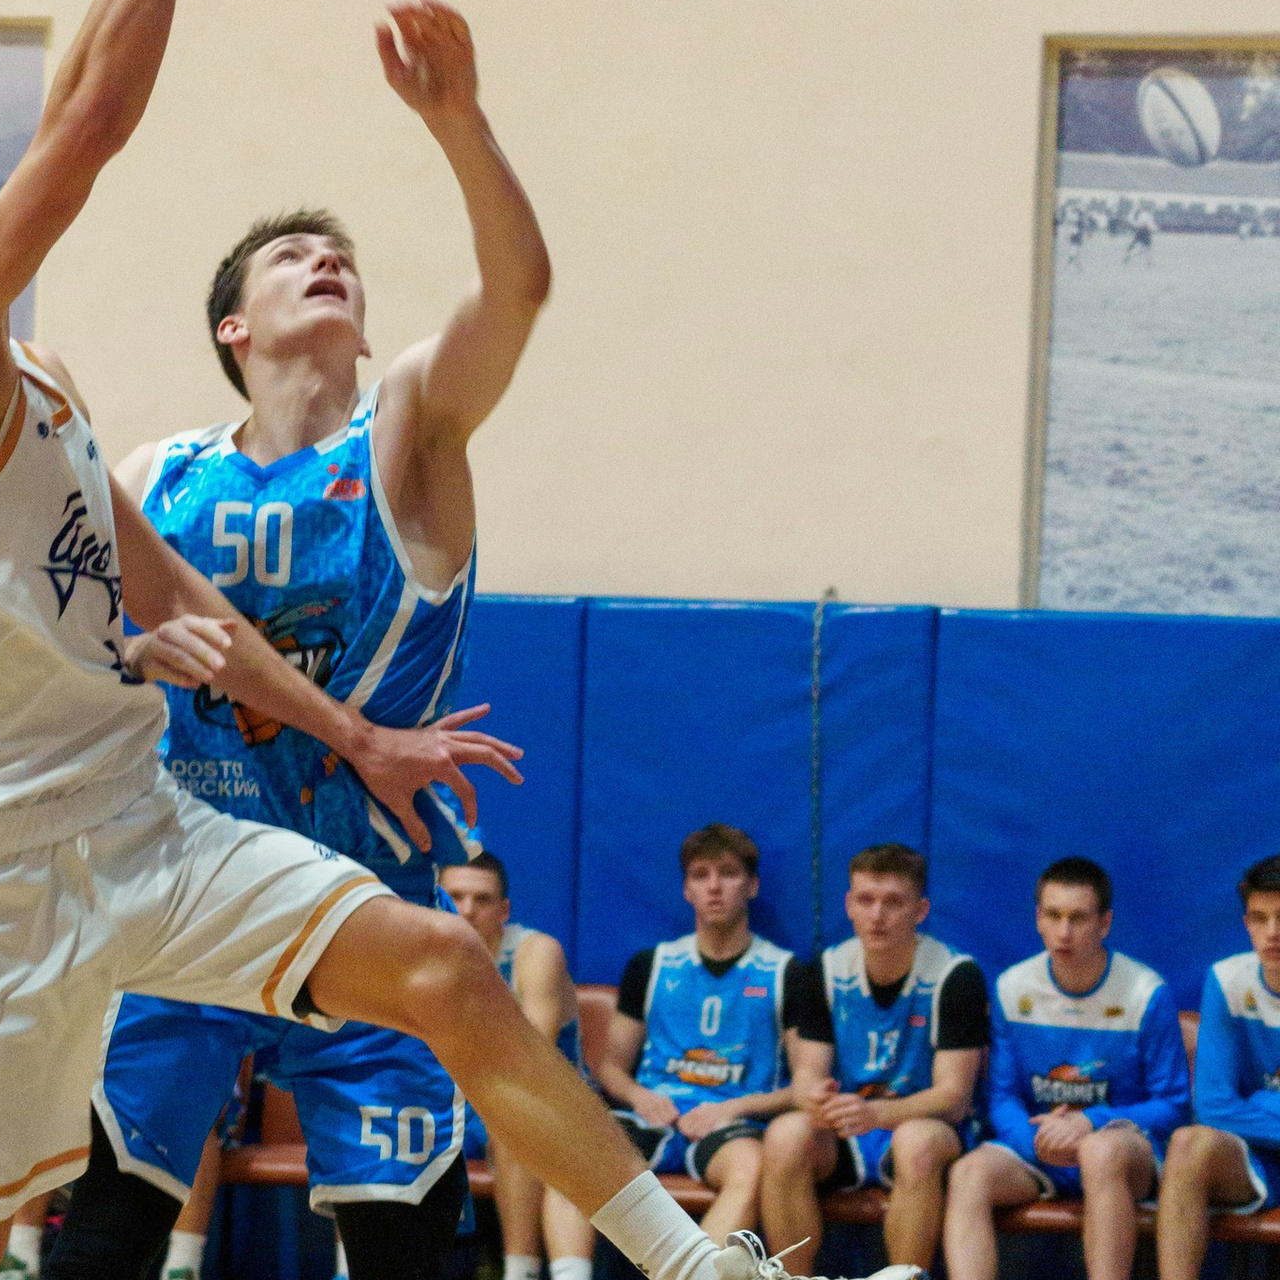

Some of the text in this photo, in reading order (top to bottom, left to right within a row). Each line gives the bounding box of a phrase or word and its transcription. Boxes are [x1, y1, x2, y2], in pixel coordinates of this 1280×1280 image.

[211, 500, 294, 589] 50
[699, 994, 722, 1037] 0
[358, 1105, 436, 1165] 50
